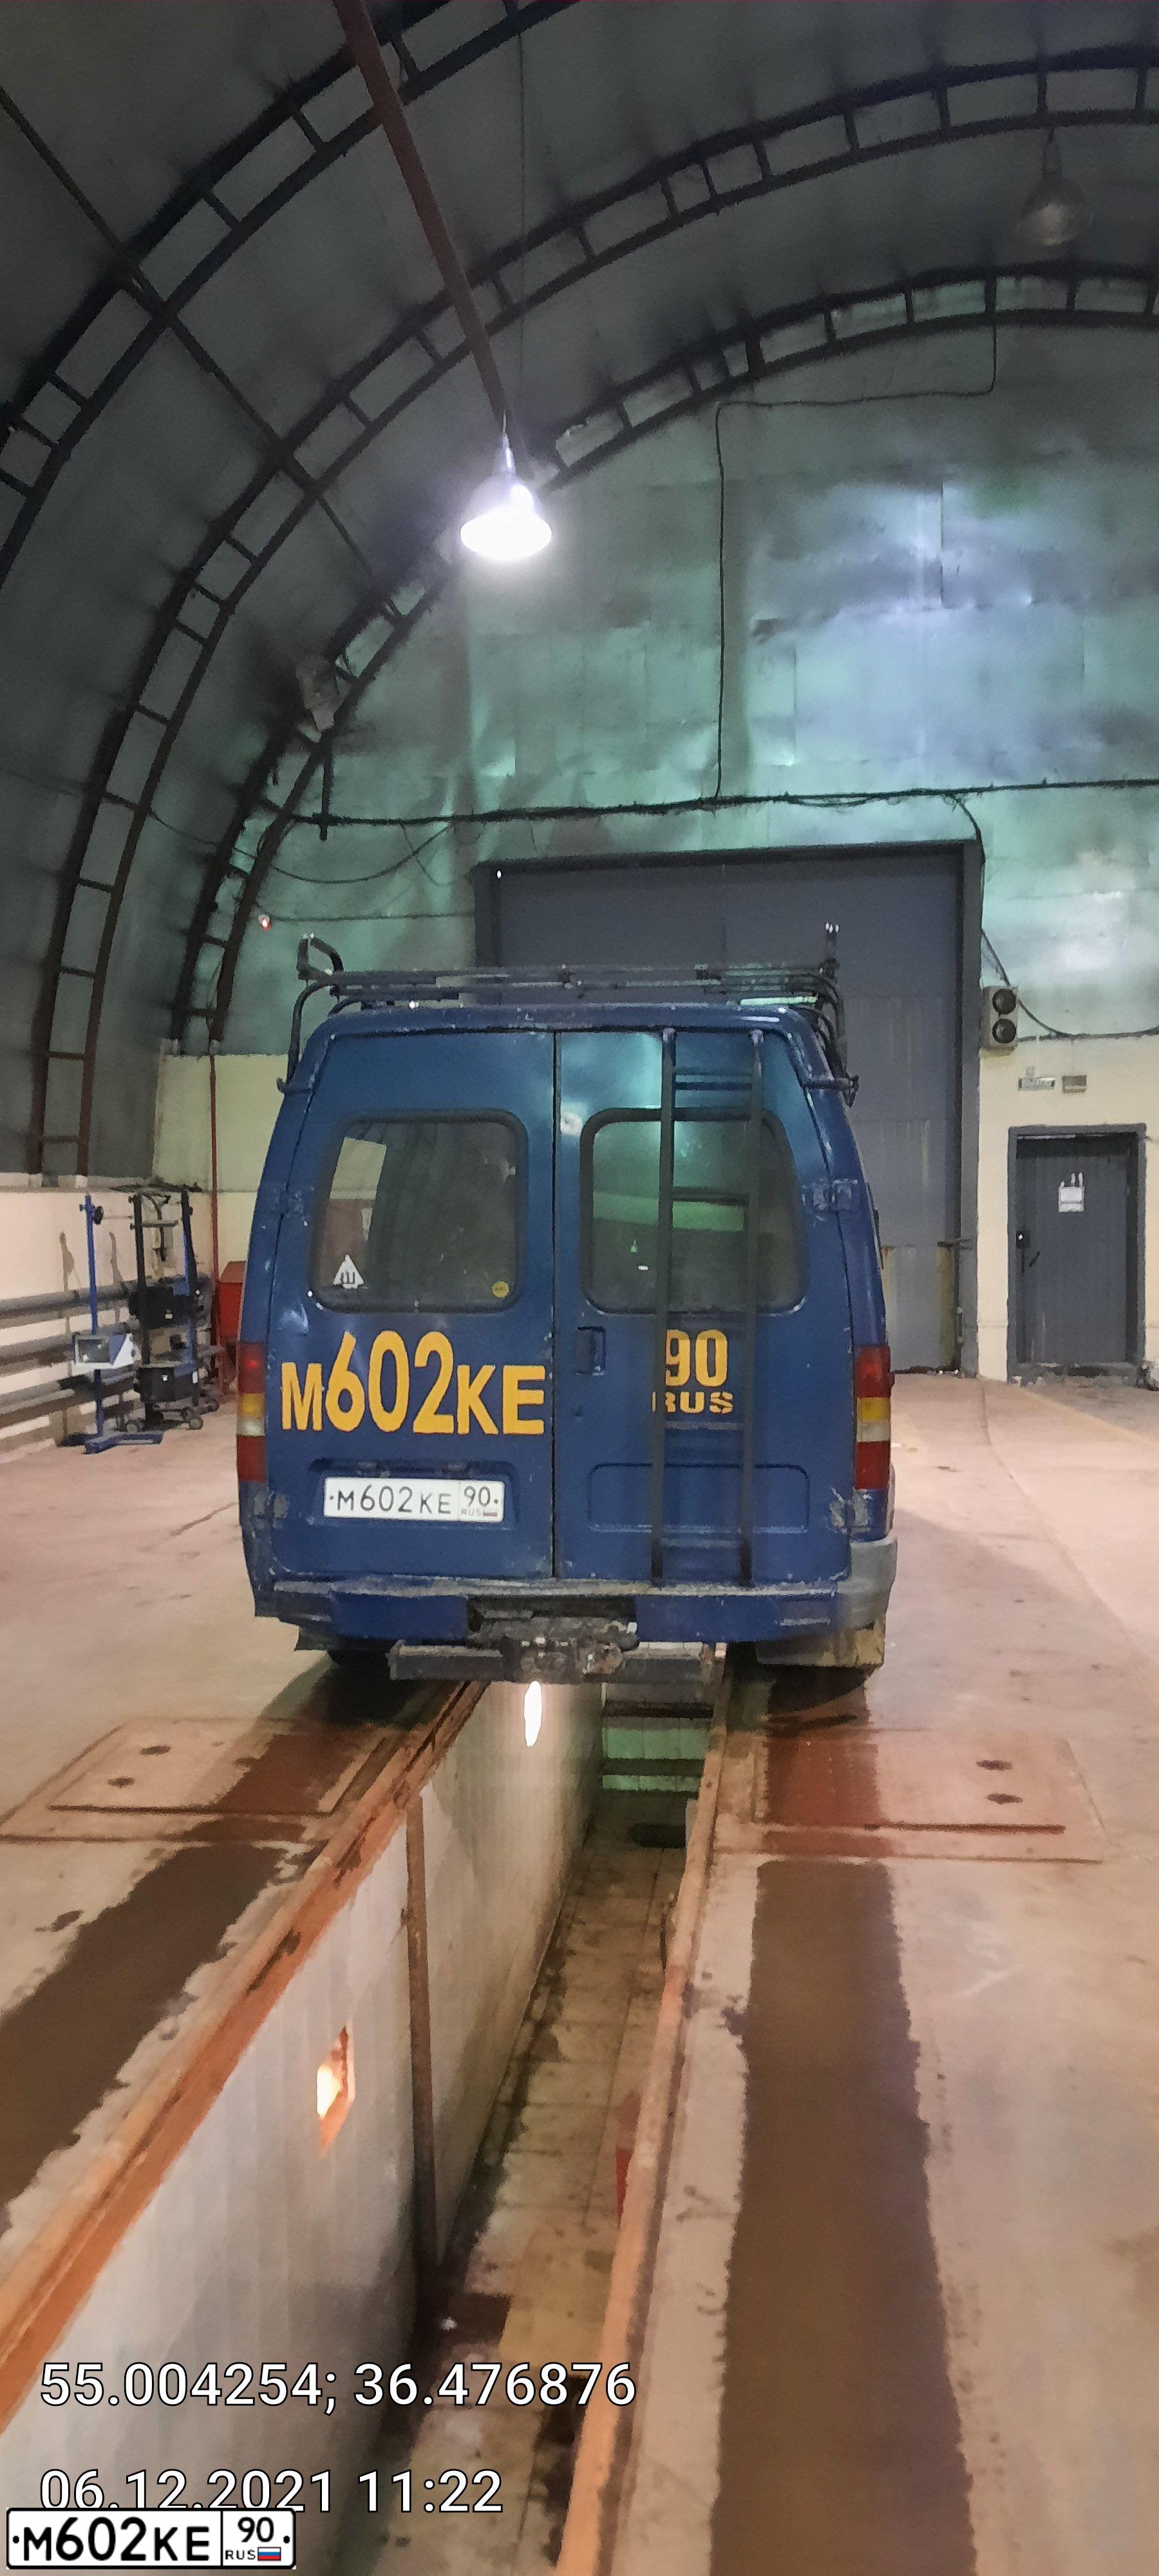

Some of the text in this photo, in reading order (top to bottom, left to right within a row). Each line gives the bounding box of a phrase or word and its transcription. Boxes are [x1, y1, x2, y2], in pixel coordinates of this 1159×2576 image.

[665, 1329, 728, 1387] 90
[652, 1391, 733, 1414] RUS
[464, 1485, 491, 1507] 90
